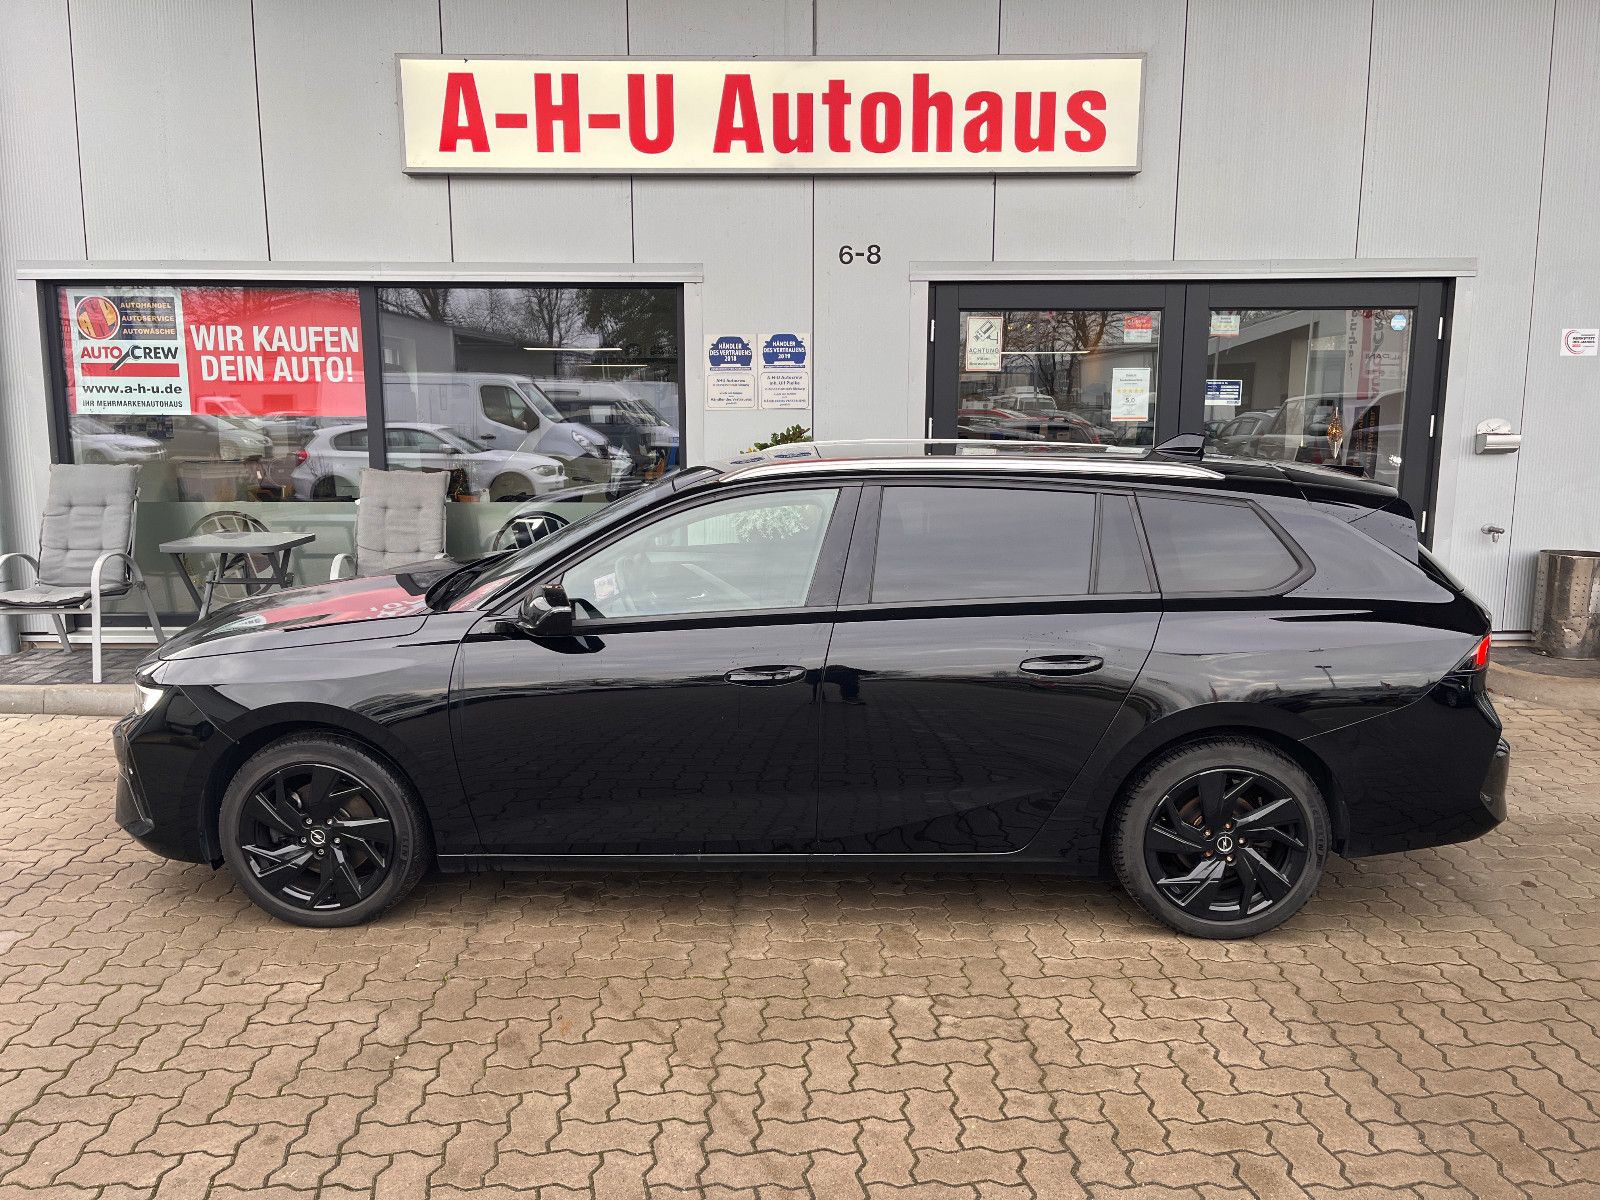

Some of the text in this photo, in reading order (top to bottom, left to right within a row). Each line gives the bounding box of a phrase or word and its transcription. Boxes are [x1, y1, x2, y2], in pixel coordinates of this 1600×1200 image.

[439, 73, 1108, 154] A-H-U Autohaus
[838, 245, 881, 265] 6-8
[122, 327, 175, 335] AUTOWÄSCHE
[190, 325, 359, 353] WIR KAUFEN
[80, 346, 178, 360] AUTO CREW
[200, 356, 354, 383] DEIN AUTO!
[82, 384, 182, 395] www.a-h-u.de
